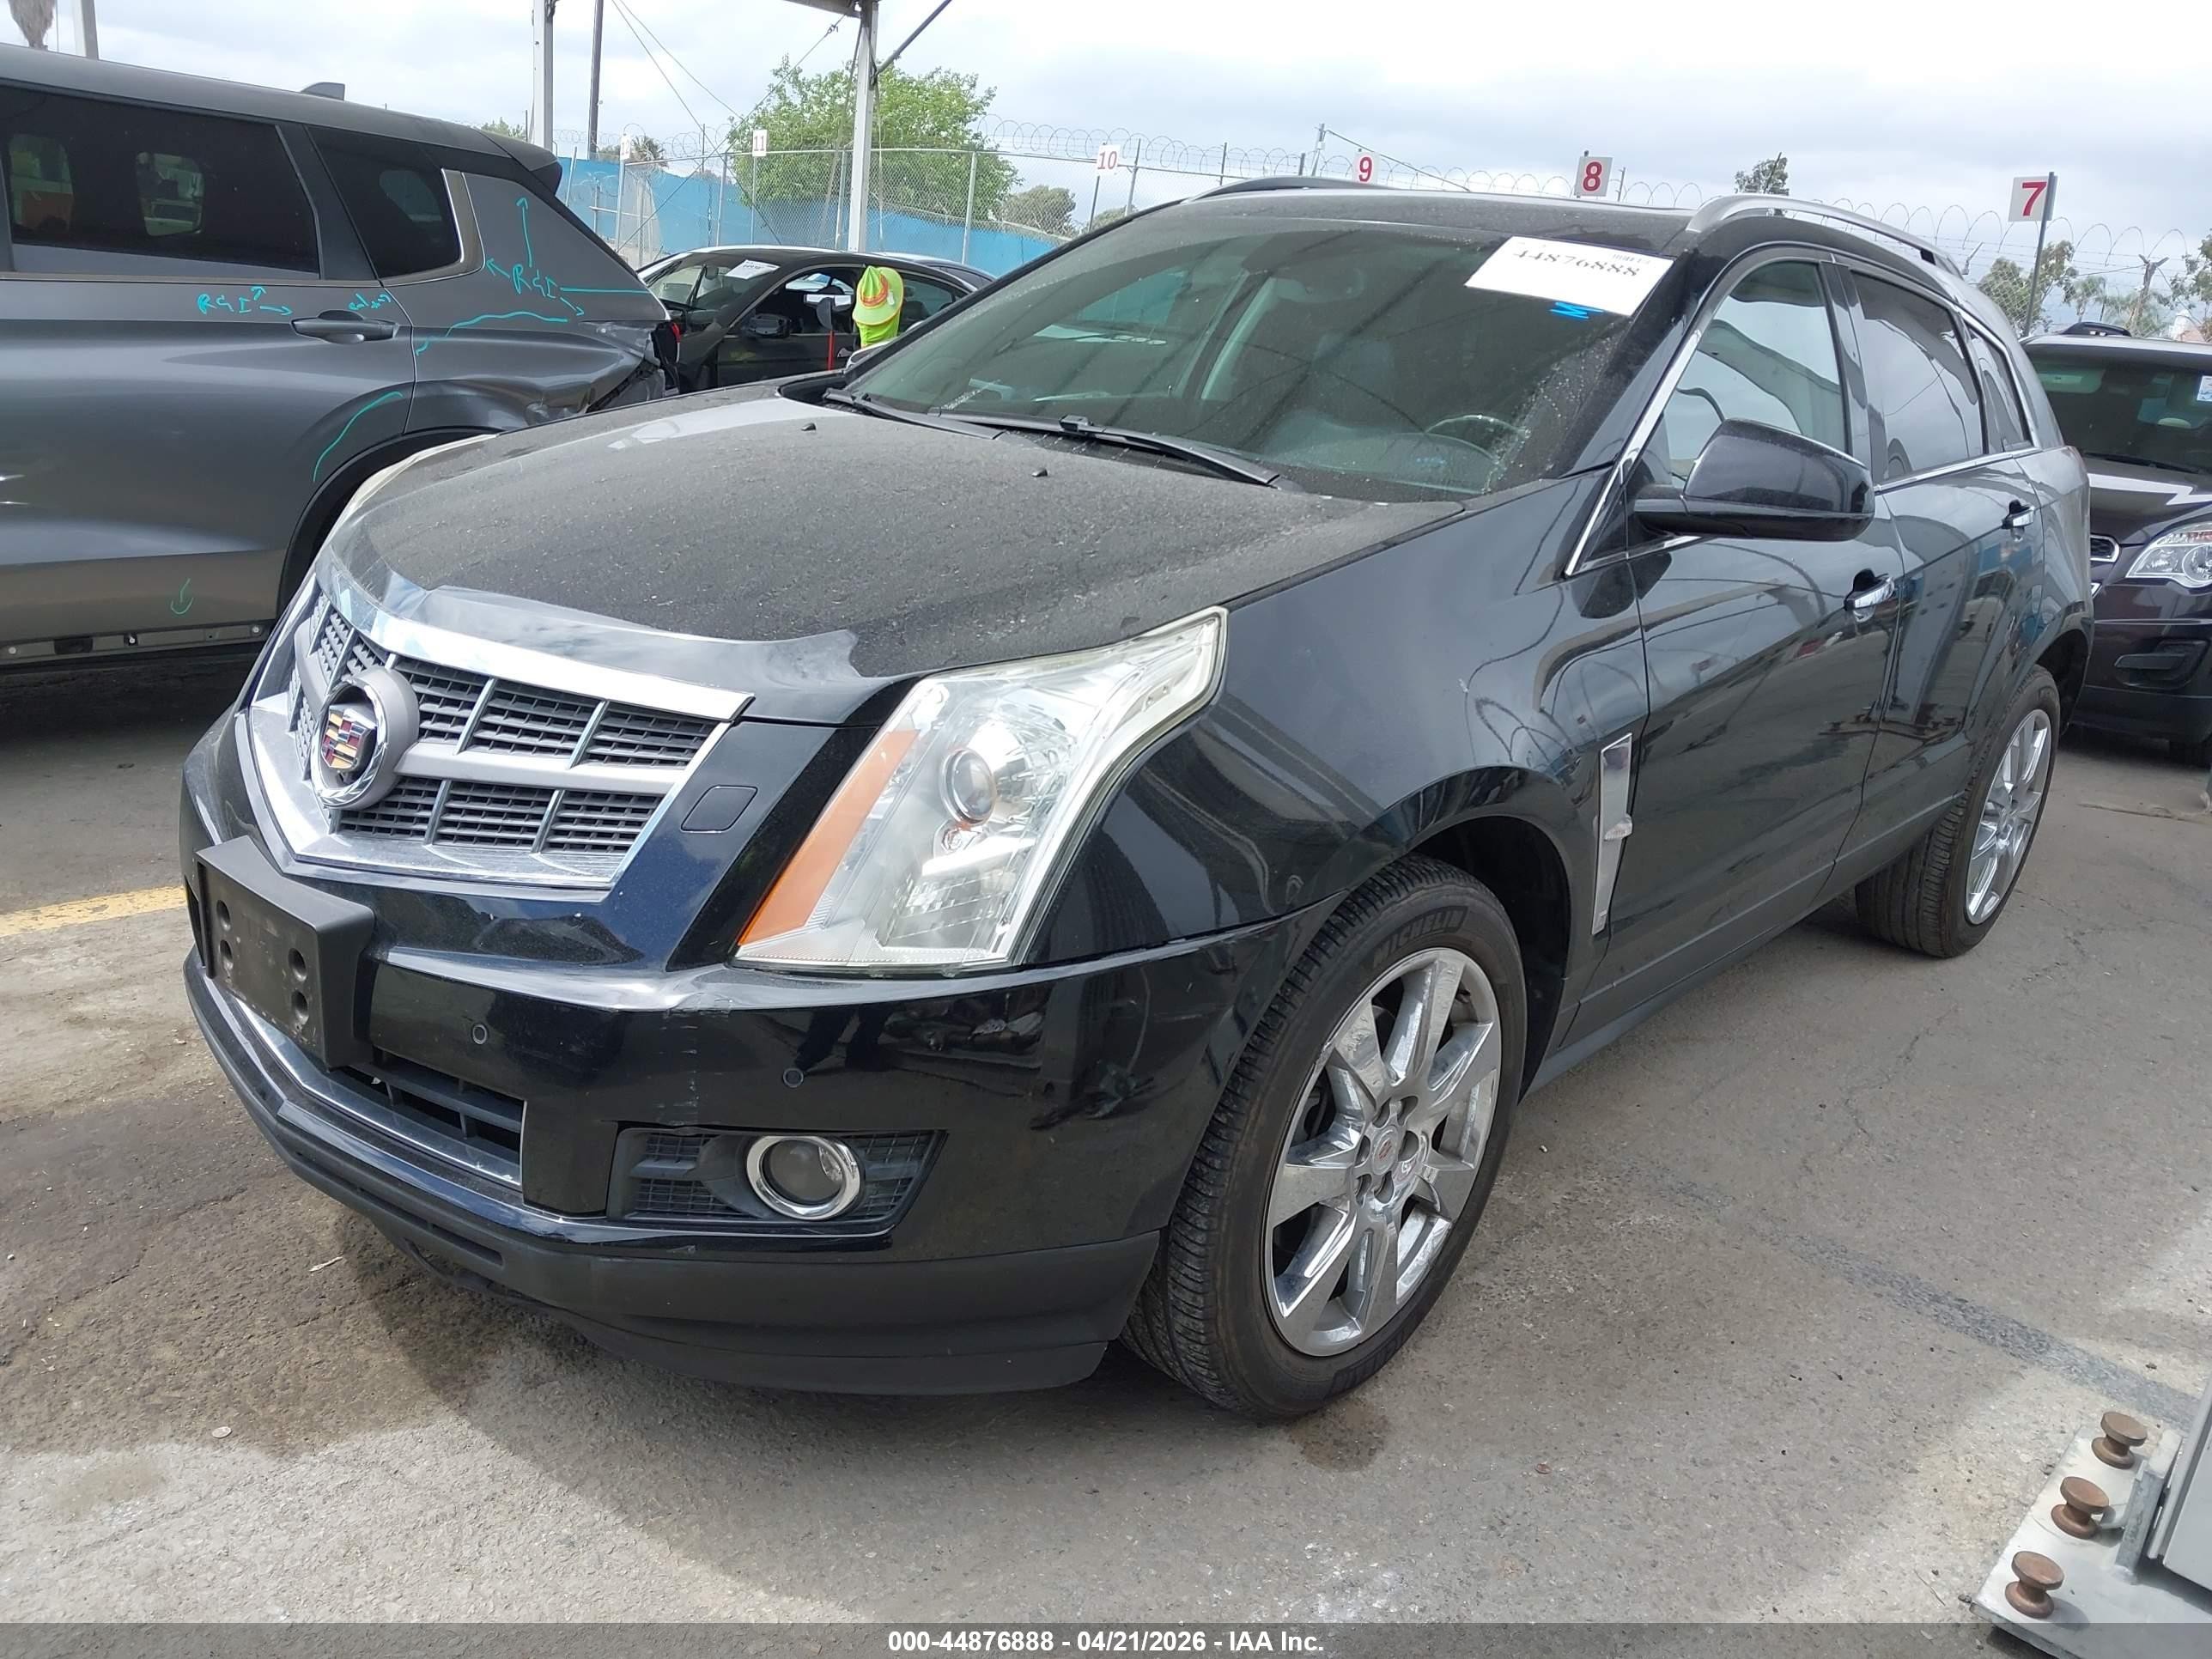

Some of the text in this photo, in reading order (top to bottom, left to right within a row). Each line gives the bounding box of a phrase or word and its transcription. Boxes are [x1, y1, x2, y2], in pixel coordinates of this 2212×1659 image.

[754, 135, 765, 151] 11
[1097, 150, 1117, 169] 10
[1358, 156, 1373, 183] 9
[1583, 161, 1602, 191] 8
[2022, 181, 2047, 216] 7
[1513, 250, 1640, 276] 44876888
[1373, 909, 1466, 968] MICHELIN
